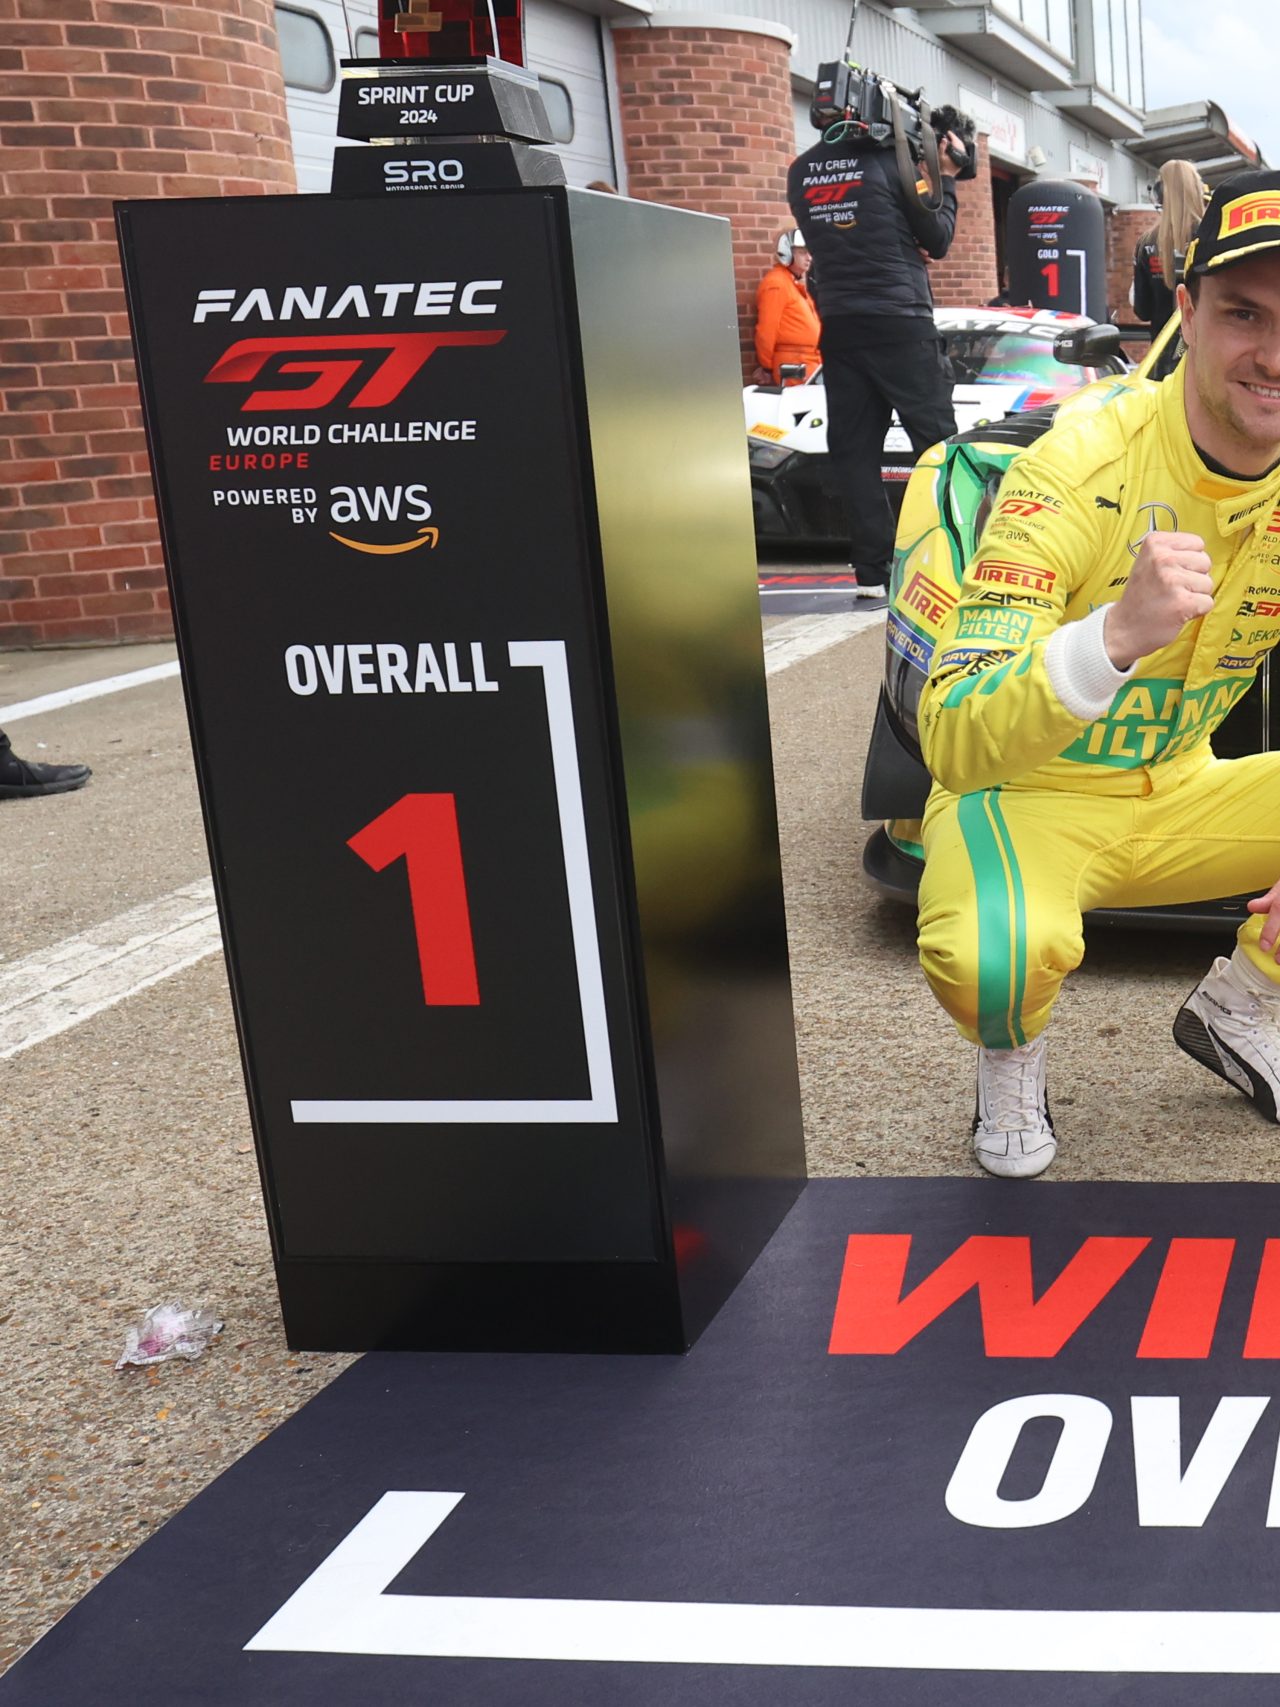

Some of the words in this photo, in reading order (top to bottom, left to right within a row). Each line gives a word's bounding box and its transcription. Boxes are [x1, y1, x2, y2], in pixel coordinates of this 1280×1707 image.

[358, 86, 429, 105] SPRINT
[435, 84, 474, 102] CUP
[399, 110, 438, 124] 2024
[383, 159, 464, 184] SRO
[808, 162, 822, 172] TV
[825, 159, 858, 170] CREW
[803, 171, 864, 186] FANATEC
[803, 180, 864, 206] GT
[833, 211, 854, 221] aws
[1037, 249, 1059, 259] GOLD
[1041, 263, 1059, 297] 1
[192, 280, 503, 323] FANATEC
[934, 319, 1064, 338] ATEC
[202, 329, 509, 412] GT
[226, 423, 321, 447] WORLD
[327, 420, 477, 444] CHALLENGE
[209, 452, 310, 471] EUROPE
[212, 487, 317, 506] POWERED
[291, 507, 318, 524] BY
[329, 483, 432, 523] aws
[1006, 529, 1031, 543] aws
[973, 560, 1057, 594] PIRELLI
[903, 570, 959, 630] PIRE
[963, 608, 1029, 630] MANN
[958, 622, 1024, 644] FILTER
[284, 641, 499, 696] OVERALL
[1220, 656, 1255, 667] RAVE
[1102, 681, 1243, 731] ANN
[1078, 713, 1224, 762] ILTER
[345, 792, 481, 1006] 1
